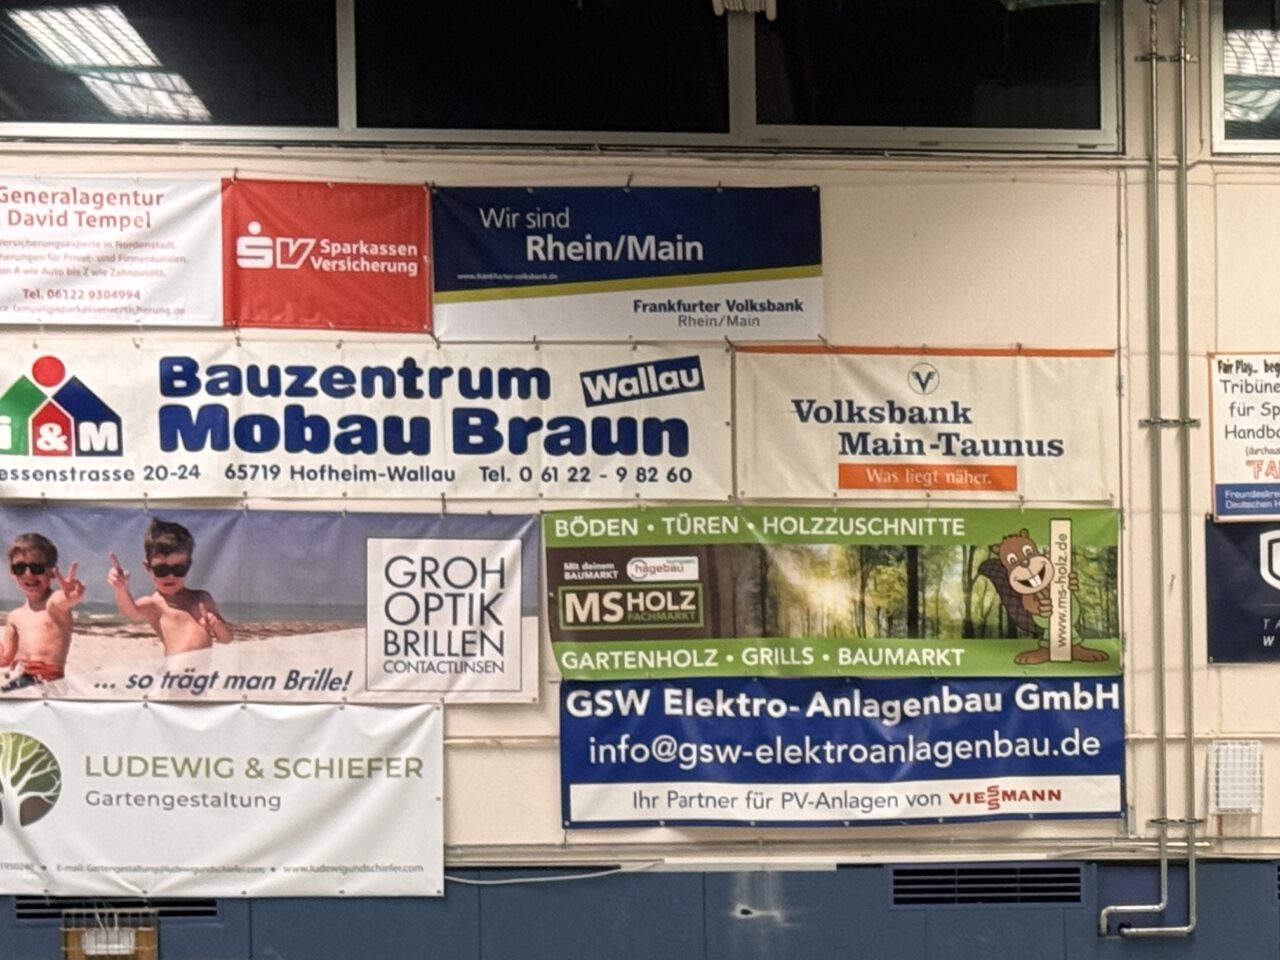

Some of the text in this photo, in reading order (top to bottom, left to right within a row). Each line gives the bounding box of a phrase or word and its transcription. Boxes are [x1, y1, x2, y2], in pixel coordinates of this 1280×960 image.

[0, 186, 164, 209] Generalagentur
[8, 209, 151, 231] David Tempel
[480, 207, 570, 229] Wir sind
[320, 239, 418, 259] Sparkassen
[527, 234, 704, 262] Rhein/Main
[311, 257, 418, 277] Versicherung
[22, 289, 141, 300] Tel. 06122 9304994
[633, 299, 804, 313] Frankfurter Volksbank
[678, 314, 760, 328] Rhein/Main
[159, 356, 701, 402] Bauzentrum Wallau
[791, 398, 973, 424] Volksbank
[1229, 401, 1254, 418] für
[159, 403, 690, 458] Mobau Braun
[143, 465, 201, 481] 20-24
[225, 465, 281, 481] 65719
[290, 465, 456, 483] Hofheim-Wallau
[479, 466, 511, 483] Tel.
[519, 467, 532, 483] 0
[541, 467, 559, 483] 61
[567, 467, 591, 483] 22
[616, 467, 628, 483] 9
[635, 467, 660, 483] 82
[666, 467, 692, 483] 60
[866, 468, 992, 487] Was liegt näher.
[555, 513, 965, 538] BÖDEN TÜREN HOLZZUSCHNITTE
[384, 556, 505, 590] GROH
[563, 561, 615, 571] Mit deinem
[563, 571, 619, 581] BAUMARKT
[635, 563, 684, 575] hagebau
[627, 590, 696, 612] HOLZ
[1056, 533, 1068, 649] www.ms-holz.de
[384, 593, 503, 627] OPTIK
[565, 591, 624, 623] MS
[627, 611, 696, 622] FACHMARKT
[384, 631, 504, 657] BRILLEN
[383, 660, 504, 675] CONTACTLINSEN
[561, 647, 965, 670] GARTENHOLZ GRILLS BAUMARKT
[126, 669, 353, 694] so trägt man Brille!
[566, 688, 650, 718] GSW
[1015, 682, 1121, 712] GmbH
[589, 734, 1100, 771] info@gsw-elektroanlagenbau.de
[85, 755, 424, 780] LUDEWIG & SCHIEFER
[86, 789, 281, 811] Gartengestaltung
[632, 790, 660, 810] Ihr
[667, 790, 739, 811] Partner
[745, 789, 774, 811] für
[781, 789, 900, 815] PV-Anlagen
[905, 792, 942, 809] von
